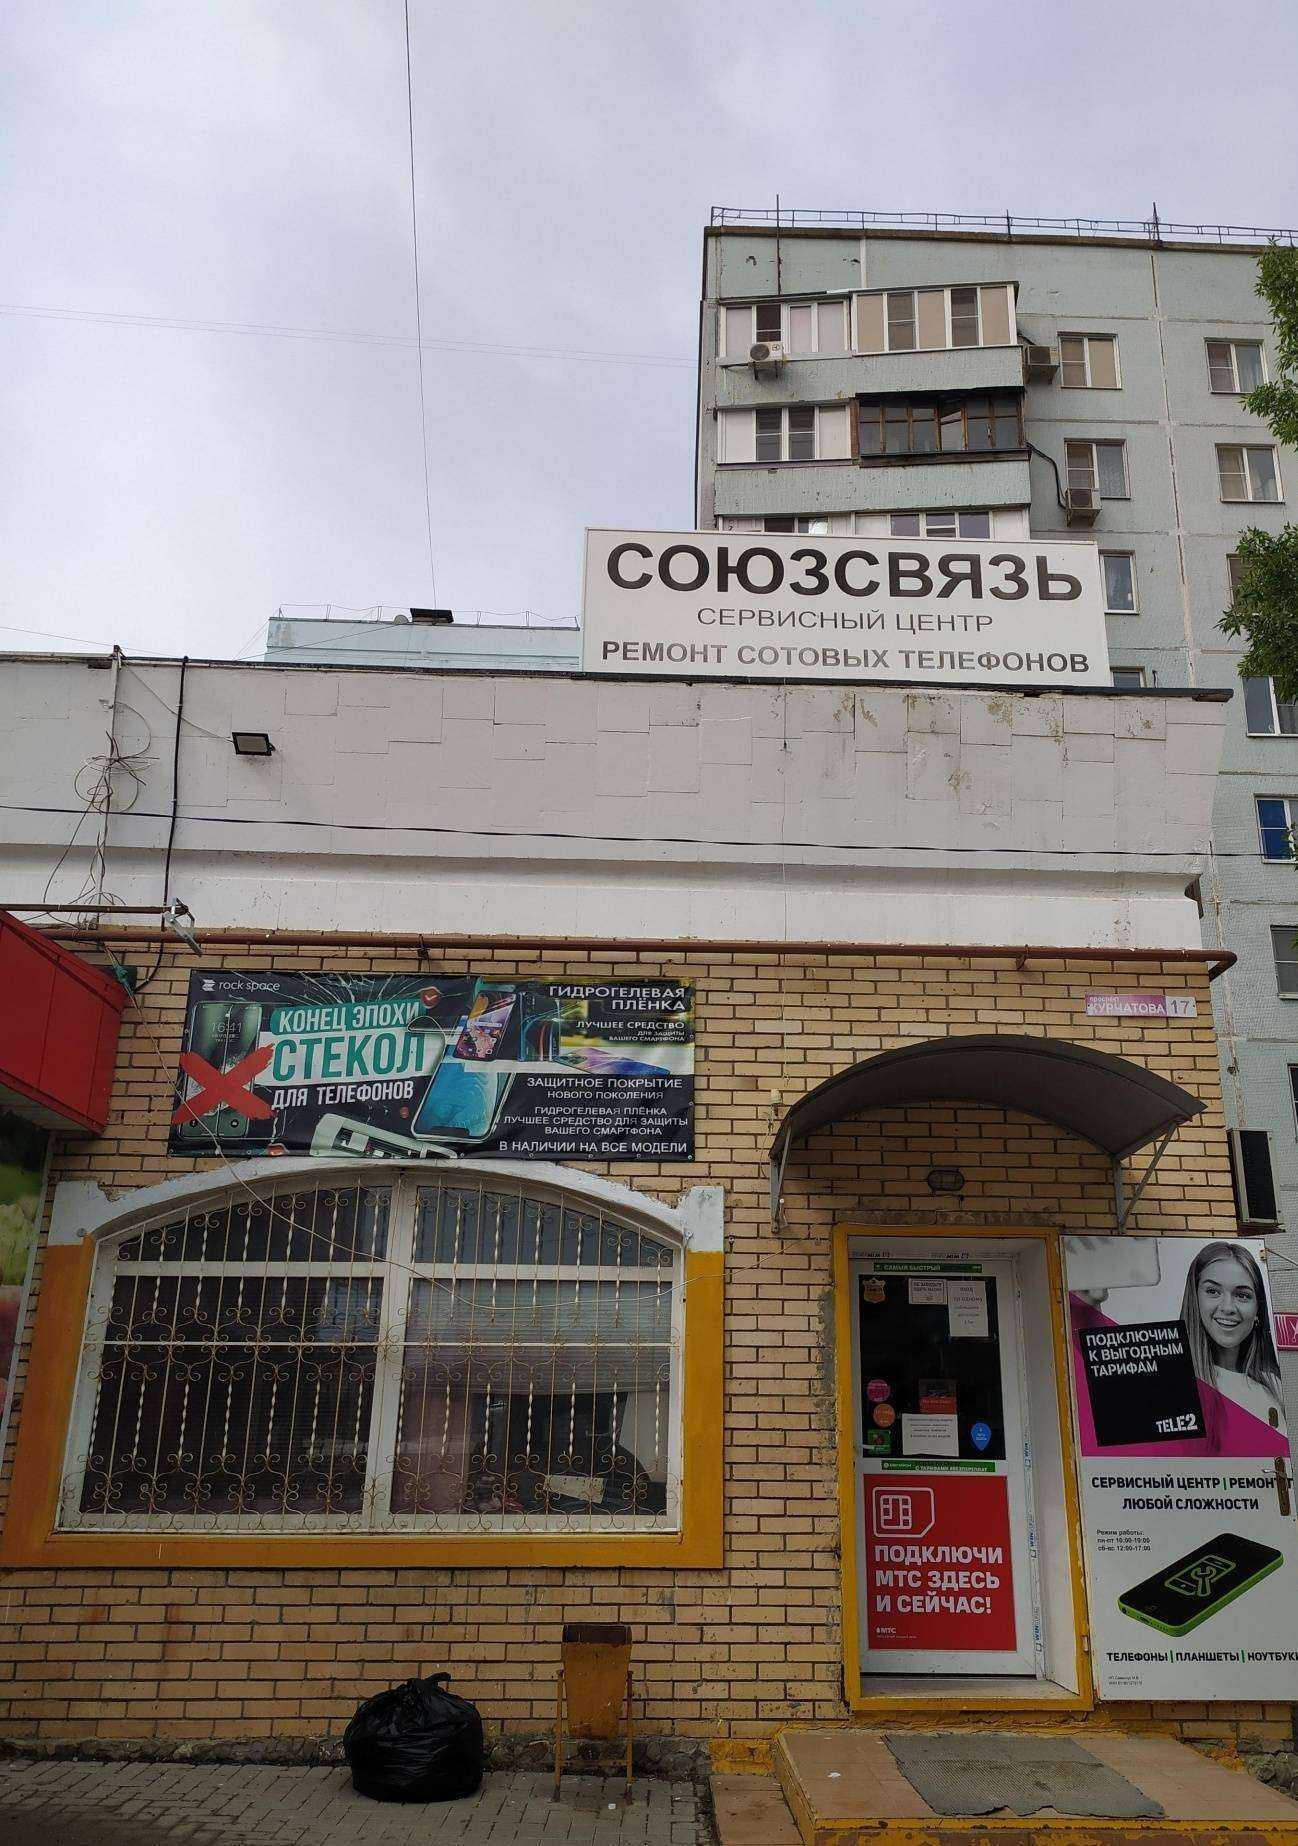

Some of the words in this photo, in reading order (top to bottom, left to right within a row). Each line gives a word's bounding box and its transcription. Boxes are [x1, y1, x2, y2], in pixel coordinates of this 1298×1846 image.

[607, 543, 1083, 600] СОЮЗСВЯЗЬ
[697, 607, 885, 631] СЕРВИСНЫЙ
[897, 612, 993, 634] ЦЕНТР
[603, 641, 727, 663] РЕМОНТ
[737, 645, 889, 668] СОТОВЫХ
[899, 649, 1089, 673] ТЕЛЕФОНОВ
[219, 981, 243, 991] rock
[247, 982, 280, 993] space
[550, 986, 685, 999] ГИДРОГЕЛЕВАЯ
[612, 998, 685, 1011] ПЛЁНКА
[1171, 999, 1190, 1014] 17
[279, 1007, 347, 1033] КОНЕЦ
[352, 1002, 420, 1027] ЭПОХИ
[576, 1021, 625, 1029] ЛУЧШЕЕ
[627, 1021, 685, 1031] СРЕДСТВО
[273, 1032, 426, 1082] СТЕКОЛ
[527, 1077, 603, 1089] ЗАЩИТНОЕ
[607, 1078, 682, 1089] ПОКРЫТИЕ
[271, 1088, 307, 1109] ДЛЯ
[317, 1081, 414, 1105] ТЕЛЕФОНОВ
[547, 1090, 593, 1099] НОВОГО
[597, 1091, 664, 1100] ПОКОЛЕНИЯ
[535, 1107, 620, 1116] ГИДРОГЕЛЕВАЯ
[624, 1106, 667, 1116] ПЛЁНКА
[504, 1116, 550, 1125] ЛУЧШЕЕ
[553, 1117, 612, 1126] СРЕДСТВО
[615, 1117, 638, 1126] ДЛЯ
[640, 1118, 688, 1127] ЗАЩИТЫ
[545, 1126, 591, 1135] ВАШЕГО
[594, 1127, 662, 1136] СМАРТФОНА
[500, 1142, 507, 1150] В
[512, 1142, 576, 1151] НАЛИЧИИ
[579, 1143, 597, 1151] НА
[602, 1143, 627, 1152] ВСЕ
[631, 1143, 687, 1154] МОДЕЛИ
[1086, 1327, 1179, 1347] ПОДКЛЮЧИМ
[1089, 1351, 1098, 1362] К
[1102, 1342, 1184, 1362] ВЫГОДНЫМ
[1091, 1360, 1158, 1377] ТАРИФАМ
[1156, 1413, 1198, 1433] TELE2
[1091, 1474, 1174, 1488] СЕРВИСНЫЙ
[1177, 1477, 1220, 1490] ЦЕНТР
[1123, 1495, 1173, 1510] ЛЮБОЙ
[1176, 1498, 1259, 1510] СЛОЖНОСТИ
[874, 1545, 1003, 1566] ПОДКЛЮЧИ
[876, 1570, 922, 1587] МТС
[928, 1571, 1000, 1591] ЗДЕСЬ
[877, 1595, 890, 1612] И
[897, 1591, 992, 1614] СЕЙЧАС!
[1106, 1652, 1168, 1662] ТЕЛЕФОНЫ
[1176, 1652, 1240, 1662] ПЛАНШЕТЫ
